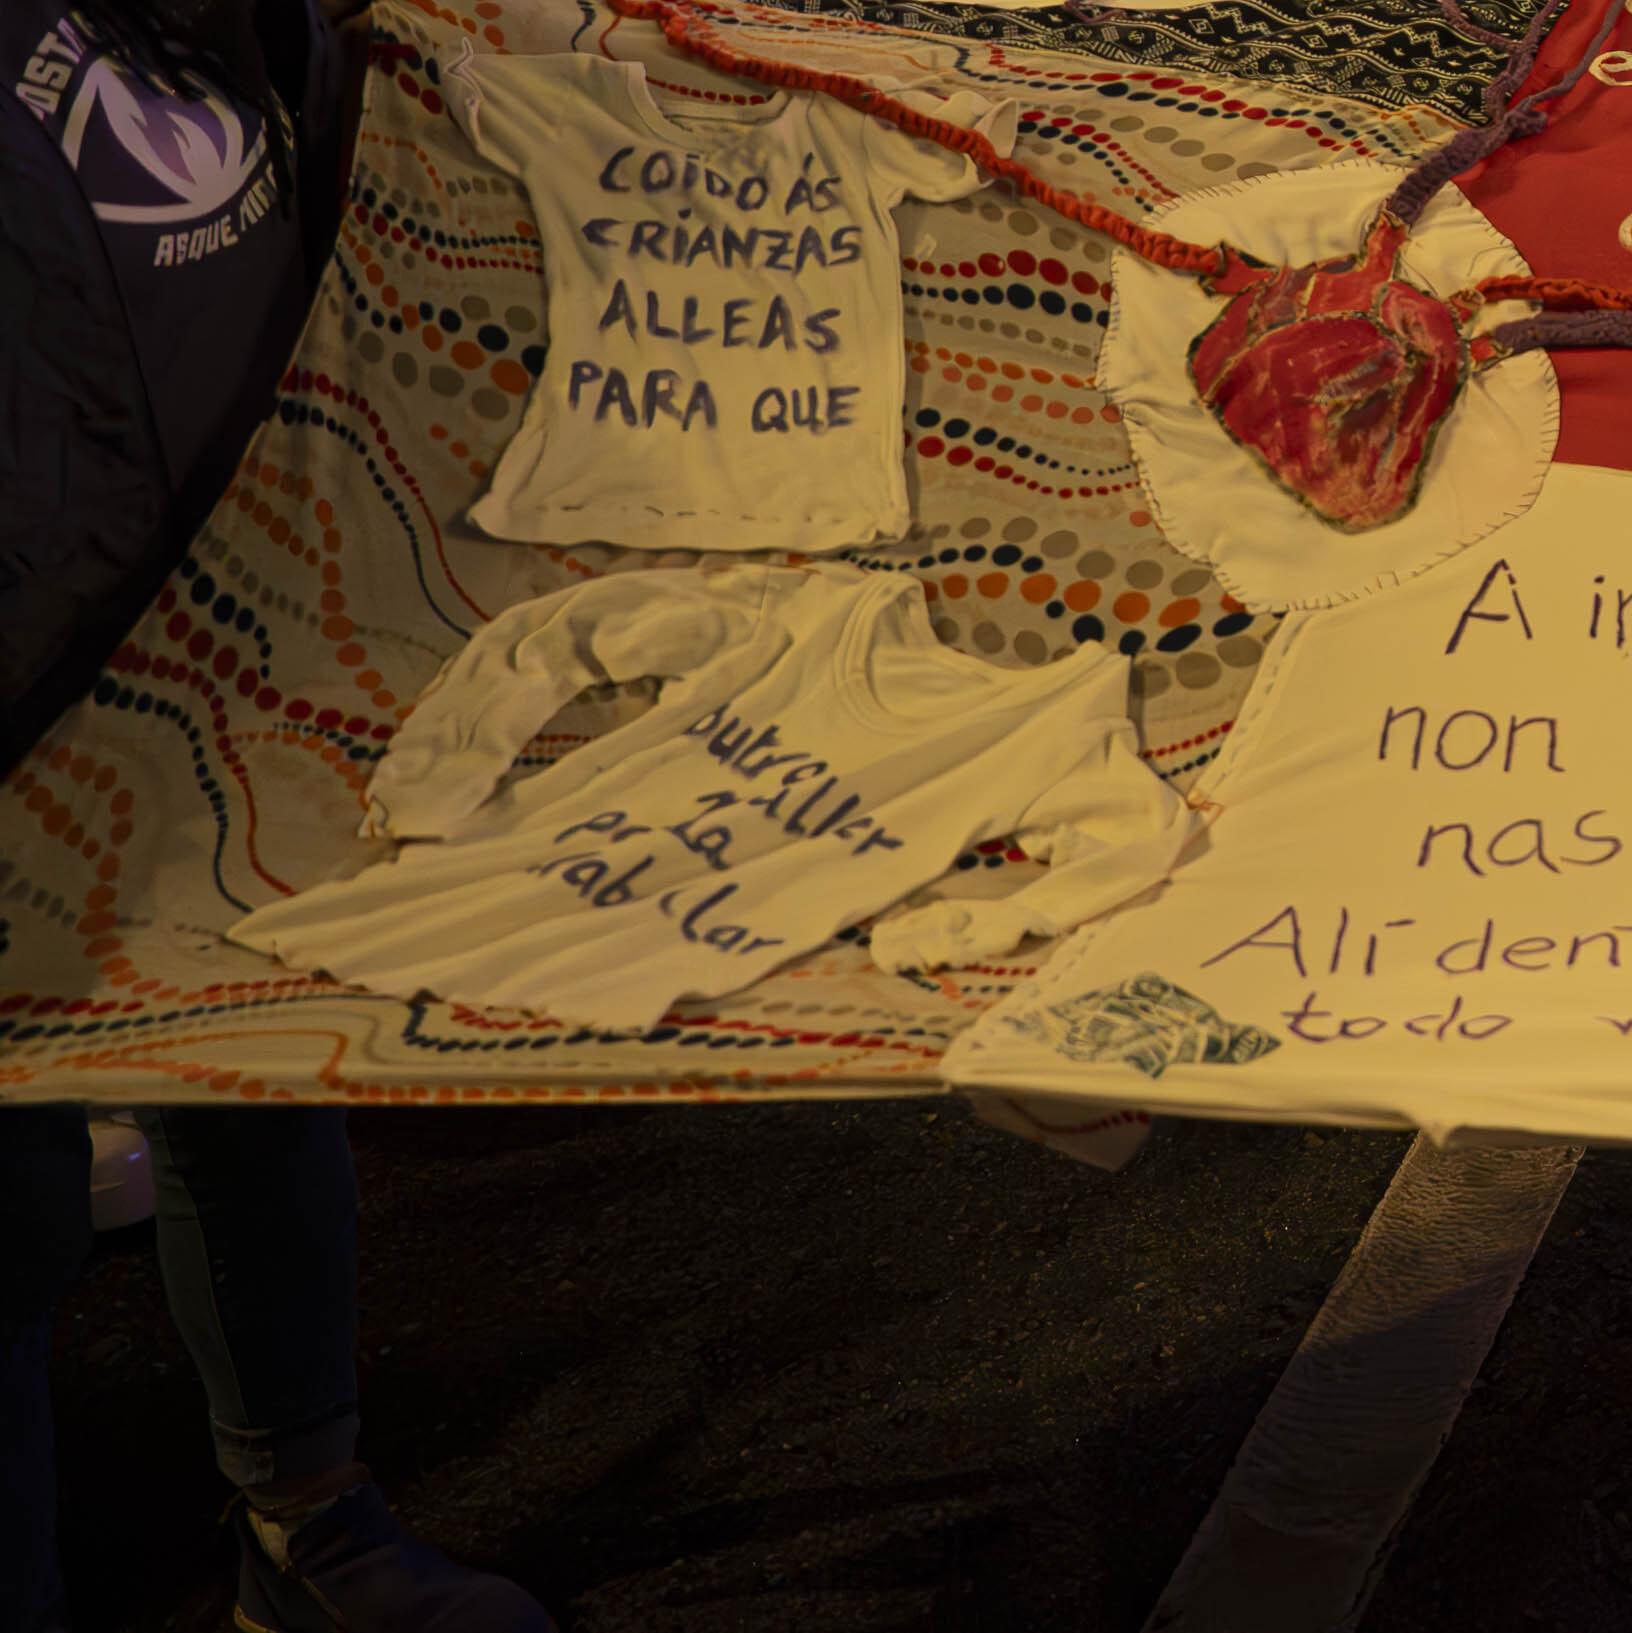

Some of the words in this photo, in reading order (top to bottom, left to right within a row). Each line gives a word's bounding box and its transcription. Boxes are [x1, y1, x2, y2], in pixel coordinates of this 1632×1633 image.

[598, 278, 843, 355] ALLEAS
[568, 359, 718, 432] PARA
[752, 385, 861, 434] QUE
[1445, 558, 1534, 656] A
[1379, 705, 1567, 773] non
[1417, 808, 1625, 877] nas
[1281, 991, 1513, 1044] todo
